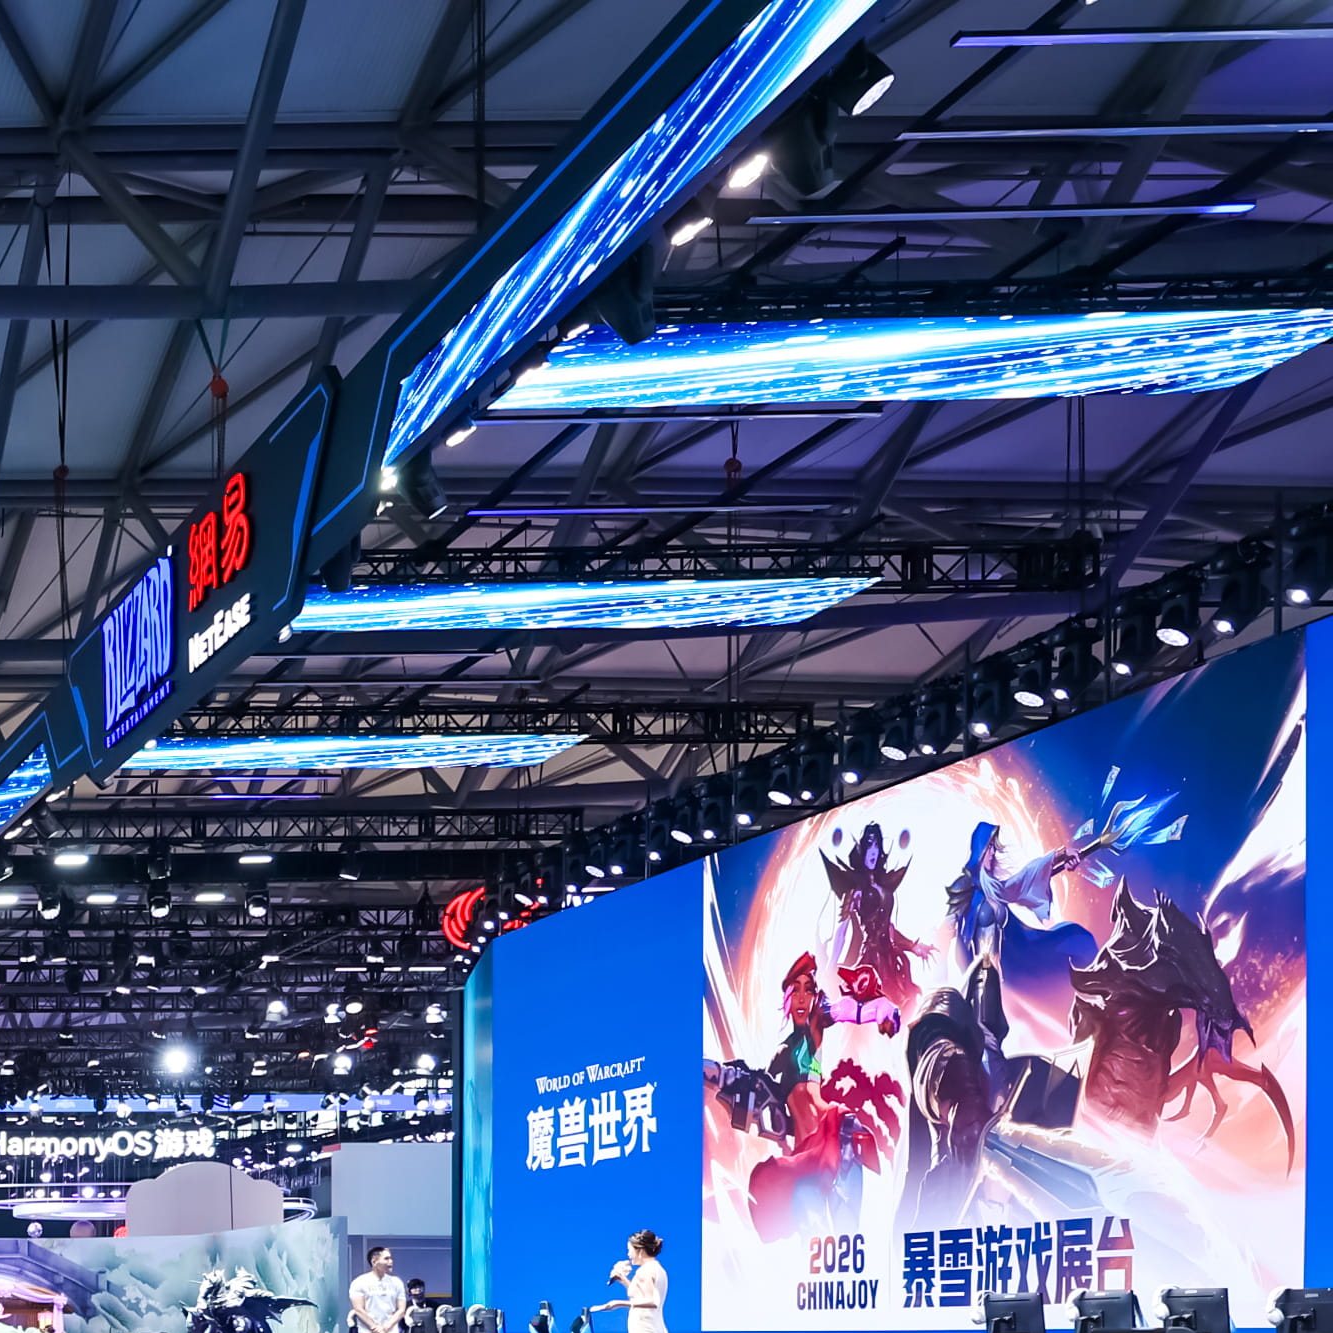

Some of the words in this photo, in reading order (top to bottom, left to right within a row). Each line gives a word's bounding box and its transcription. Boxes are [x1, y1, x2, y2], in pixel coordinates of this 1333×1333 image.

[188, 473, 250, 613] 網易
[102, 557, 173, 731] BLIZZARD
[106, 680, 173, 749] ENTERTAINMENT
[526, 1082, 657, 1171] 魔兽世界
[796, 1279, 879, 1311] CHINAJOY
[809, 1234, 865, 1274] 2026
[902, 1216, 1135, 1308] 暴雪游戏展台
